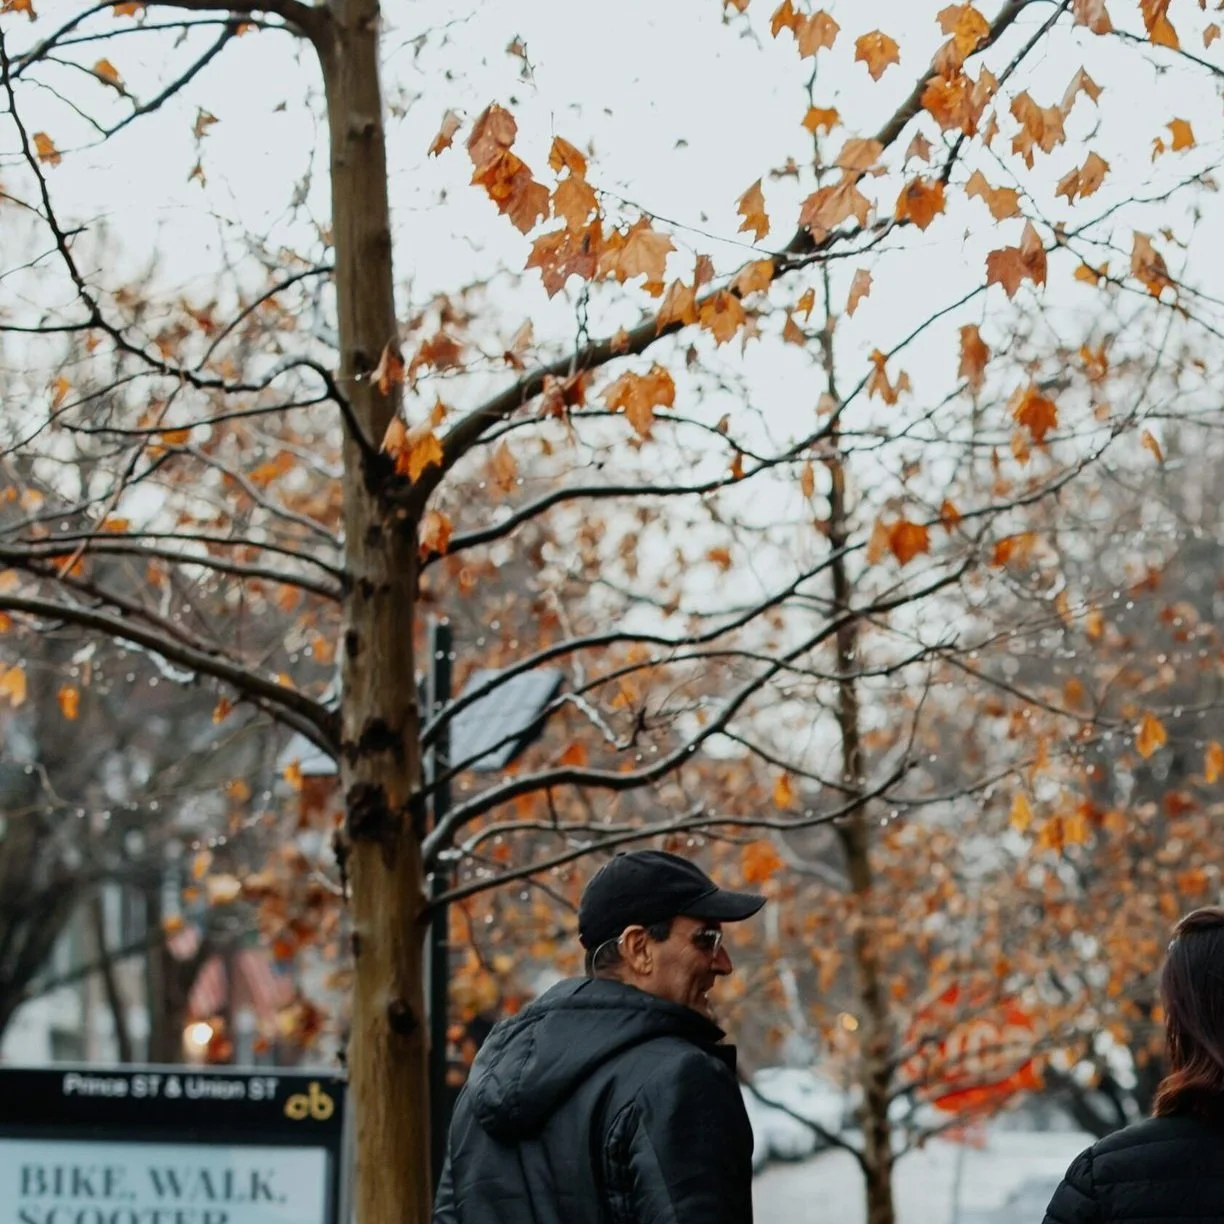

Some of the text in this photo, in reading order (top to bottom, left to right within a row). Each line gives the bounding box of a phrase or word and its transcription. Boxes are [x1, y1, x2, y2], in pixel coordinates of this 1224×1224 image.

[63, 1073, 278, 1100] Prince ST & Union ST
